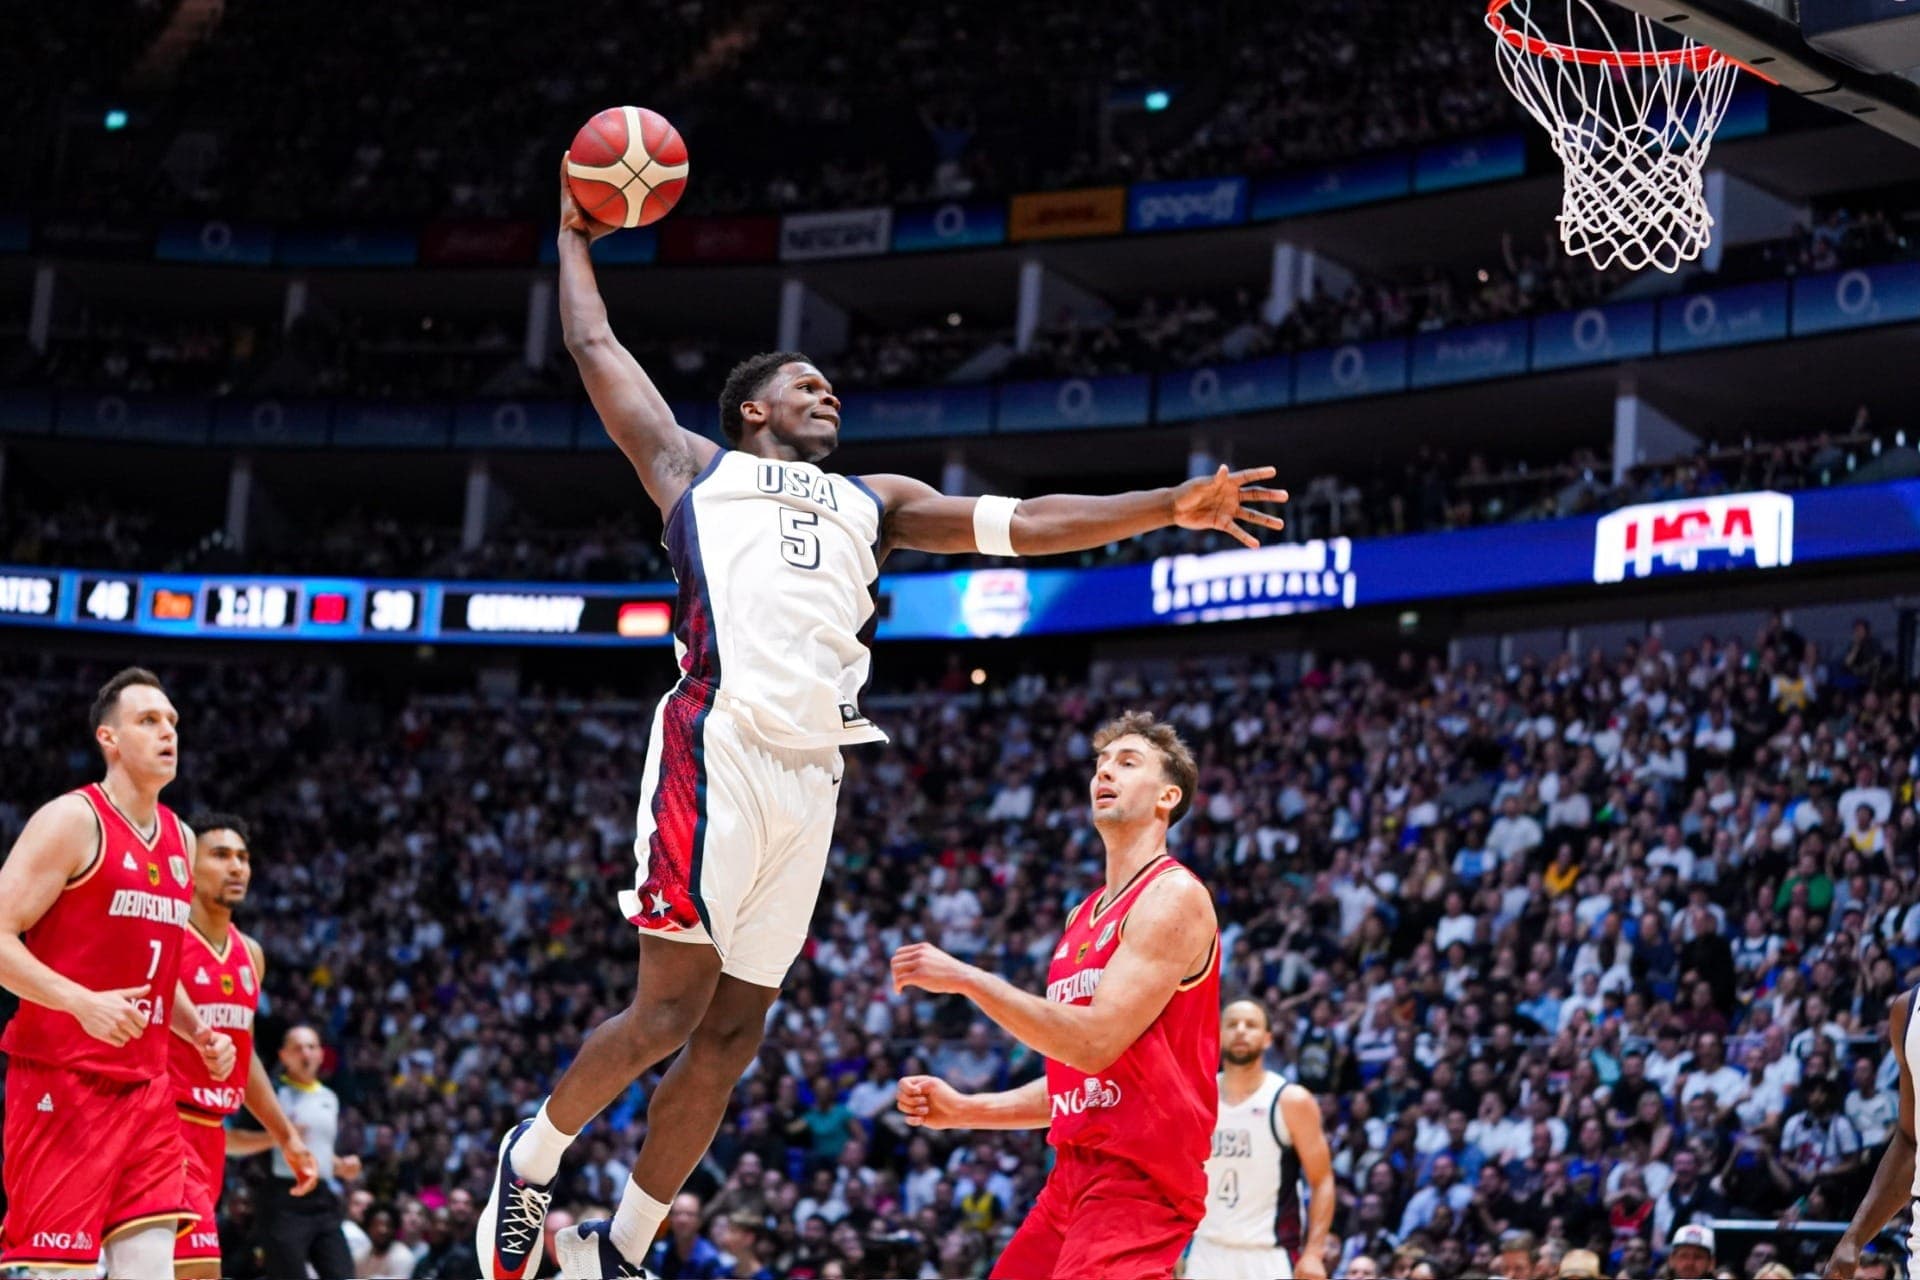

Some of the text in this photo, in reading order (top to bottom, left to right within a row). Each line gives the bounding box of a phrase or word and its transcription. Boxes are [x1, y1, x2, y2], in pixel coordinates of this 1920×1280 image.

[757, 464, 838, 512] USA
[779, 506, 820, 570] 5
[467, 595, 585, 631] GERMANY
[109, 889, 191, 929] DEUTSCHLAN
[146, 939, 162, 979] 7
[1051, 1088, 1086, 1118] NG
[1216, 1168, 1239, 1208] 4
[33, 1232, 71, 1250] ING
